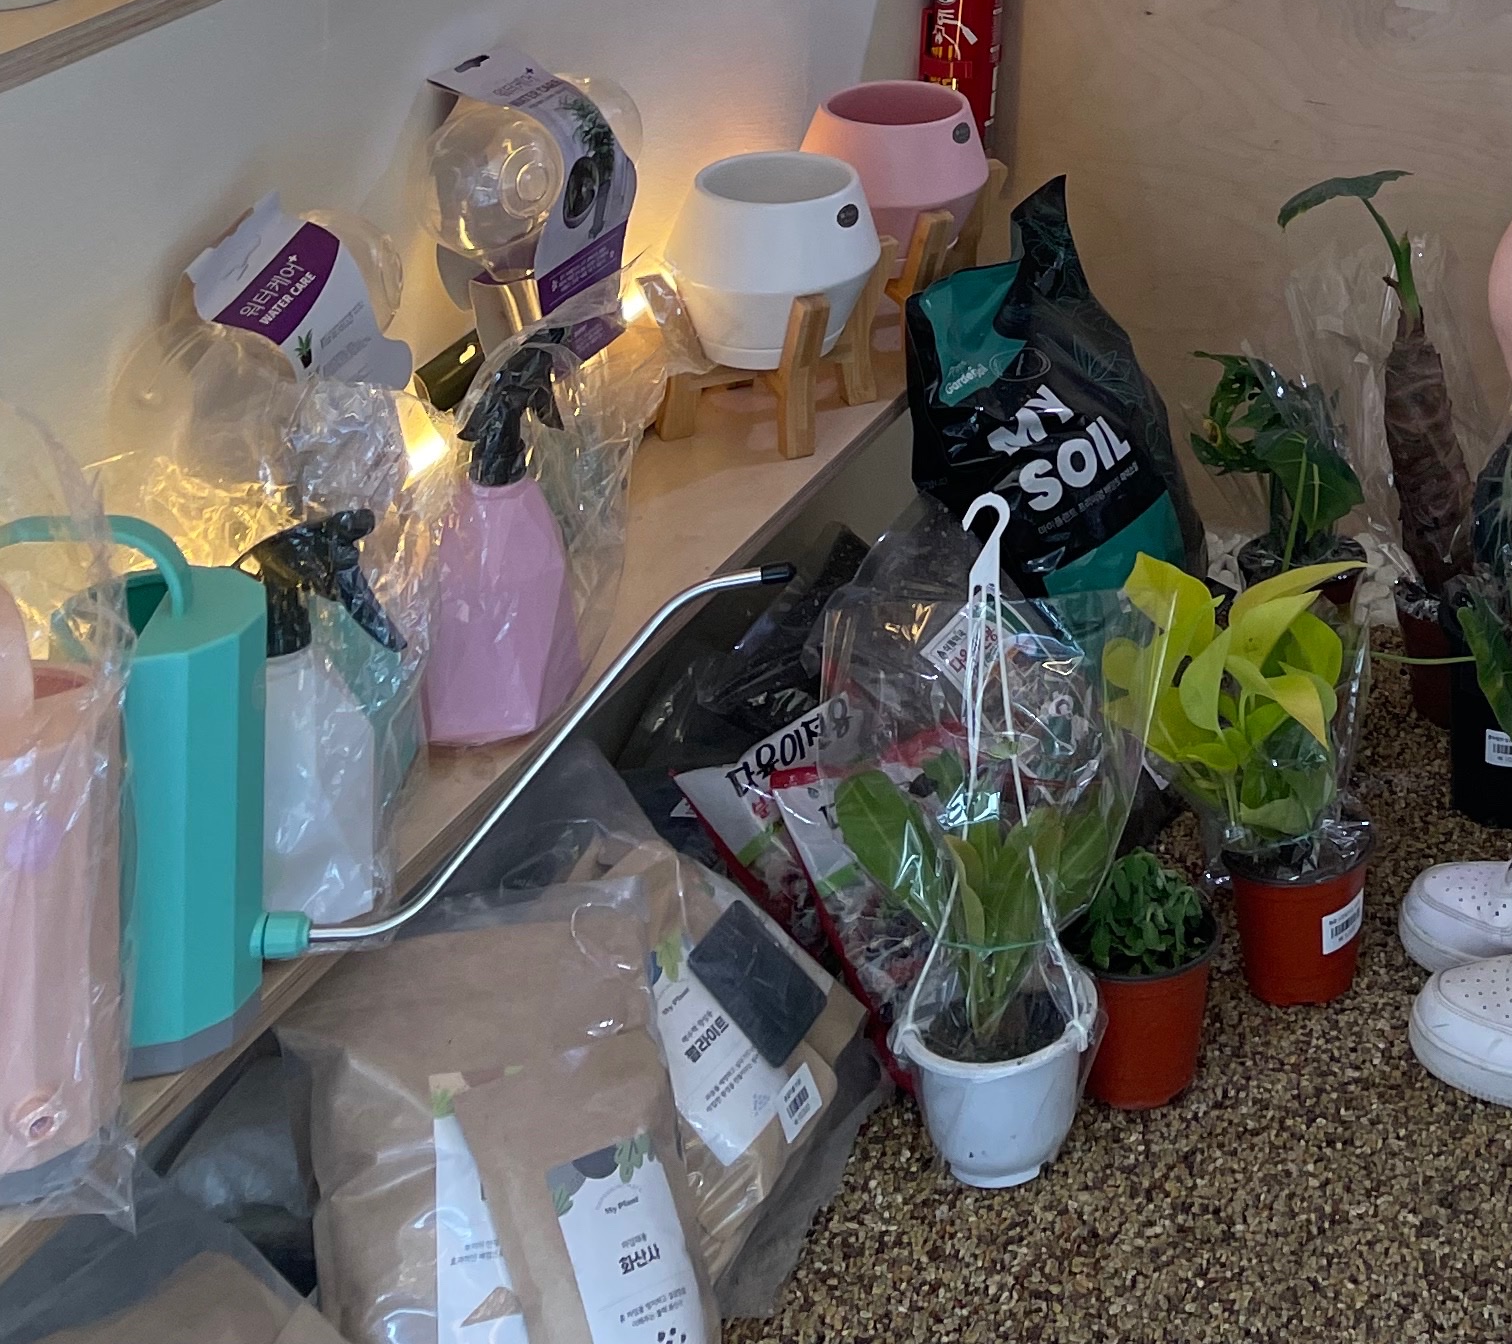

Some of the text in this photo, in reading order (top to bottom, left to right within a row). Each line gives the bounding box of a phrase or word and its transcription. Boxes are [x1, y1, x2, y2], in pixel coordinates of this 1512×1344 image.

[259, 271, 317, 326] WATER CARE
[987, 384, 1075, 457] MY
[1018, 415, 1132, 511] SOIL
